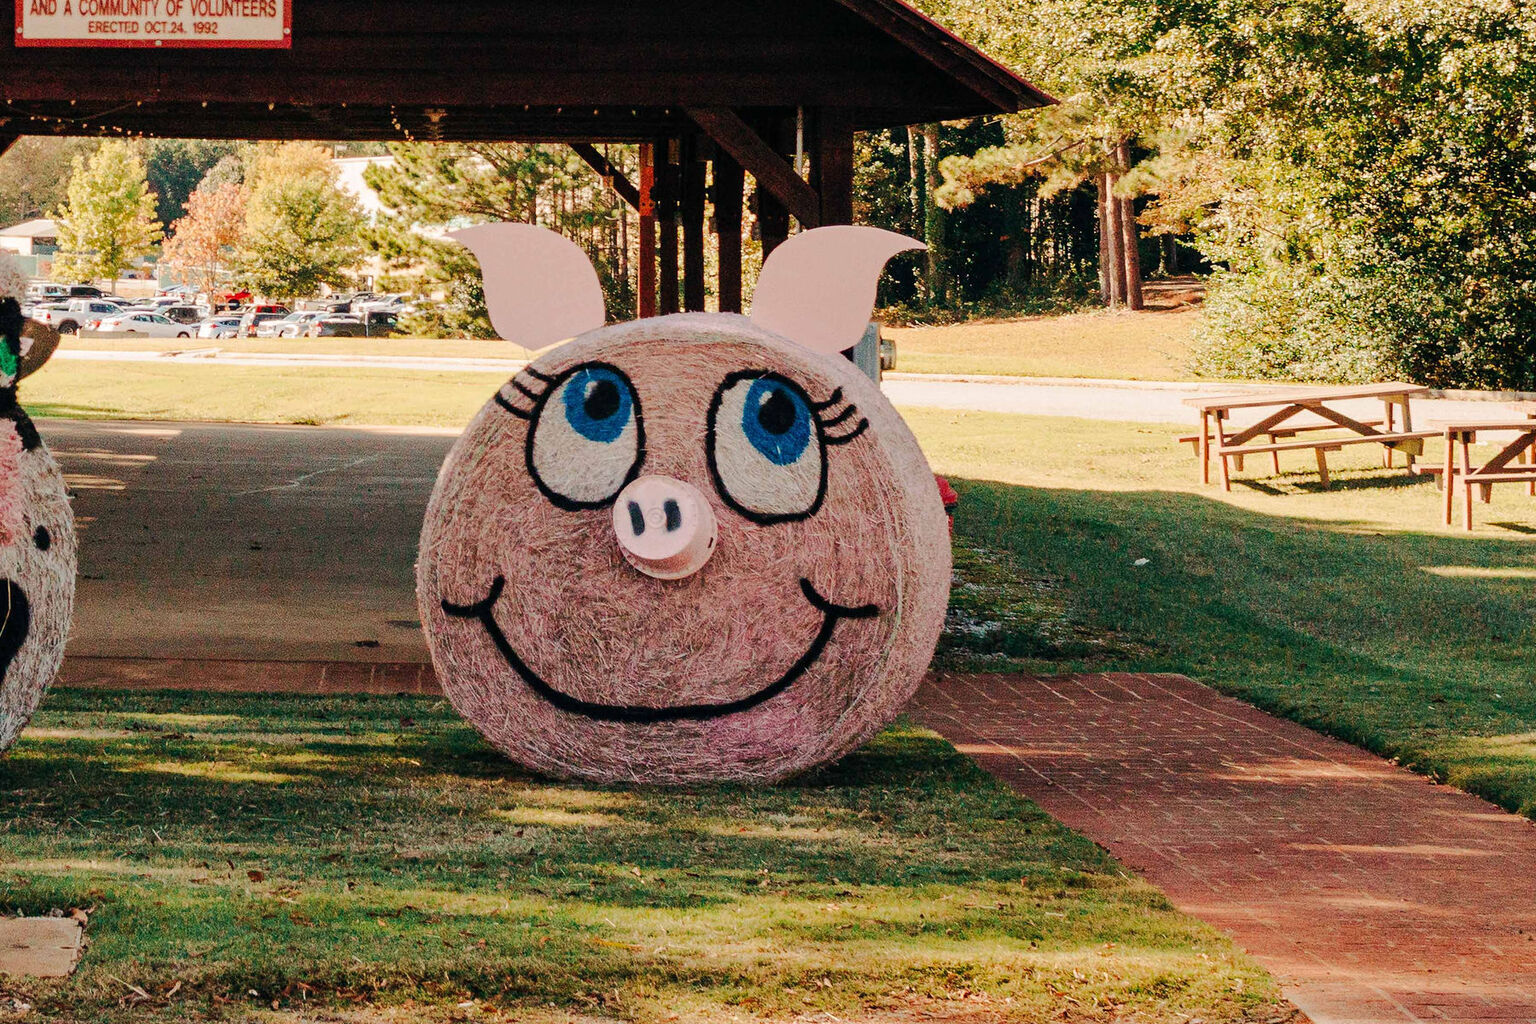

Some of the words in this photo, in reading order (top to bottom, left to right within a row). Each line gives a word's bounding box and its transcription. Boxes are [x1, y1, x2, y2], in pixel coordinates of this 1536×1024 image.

[190, 0, 277, 18] VOLUNTEERS
[88, 22, 139, 34] ERECTED
[193, 22, 218, 35] 1992
